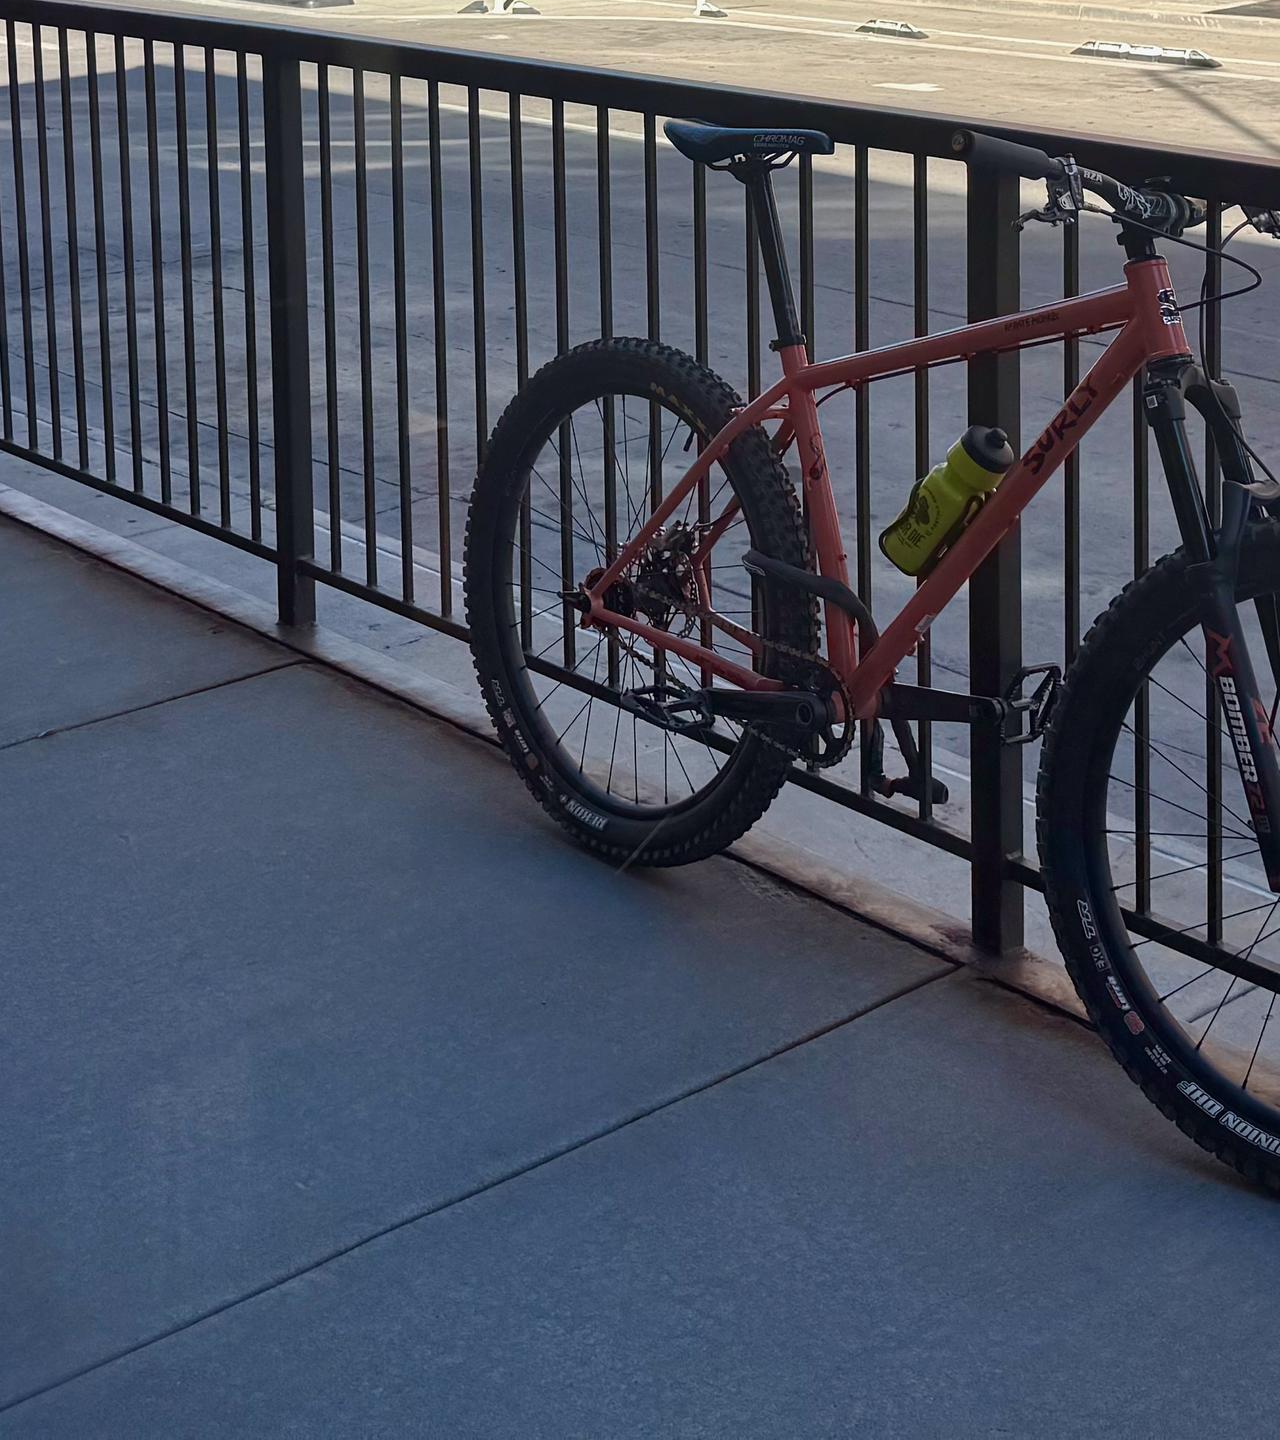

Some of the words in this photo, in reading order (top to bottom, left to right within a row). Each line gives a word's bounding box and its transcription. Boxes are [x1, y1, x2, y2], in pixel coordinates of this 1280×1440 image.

[1023, 376, 1099, 475] SURLY
[1219, 675, 1260, 784] BOMBER
[1091, 944, 1109, 972] EXO
[1176, 1081, 1225, 1119] DHF
